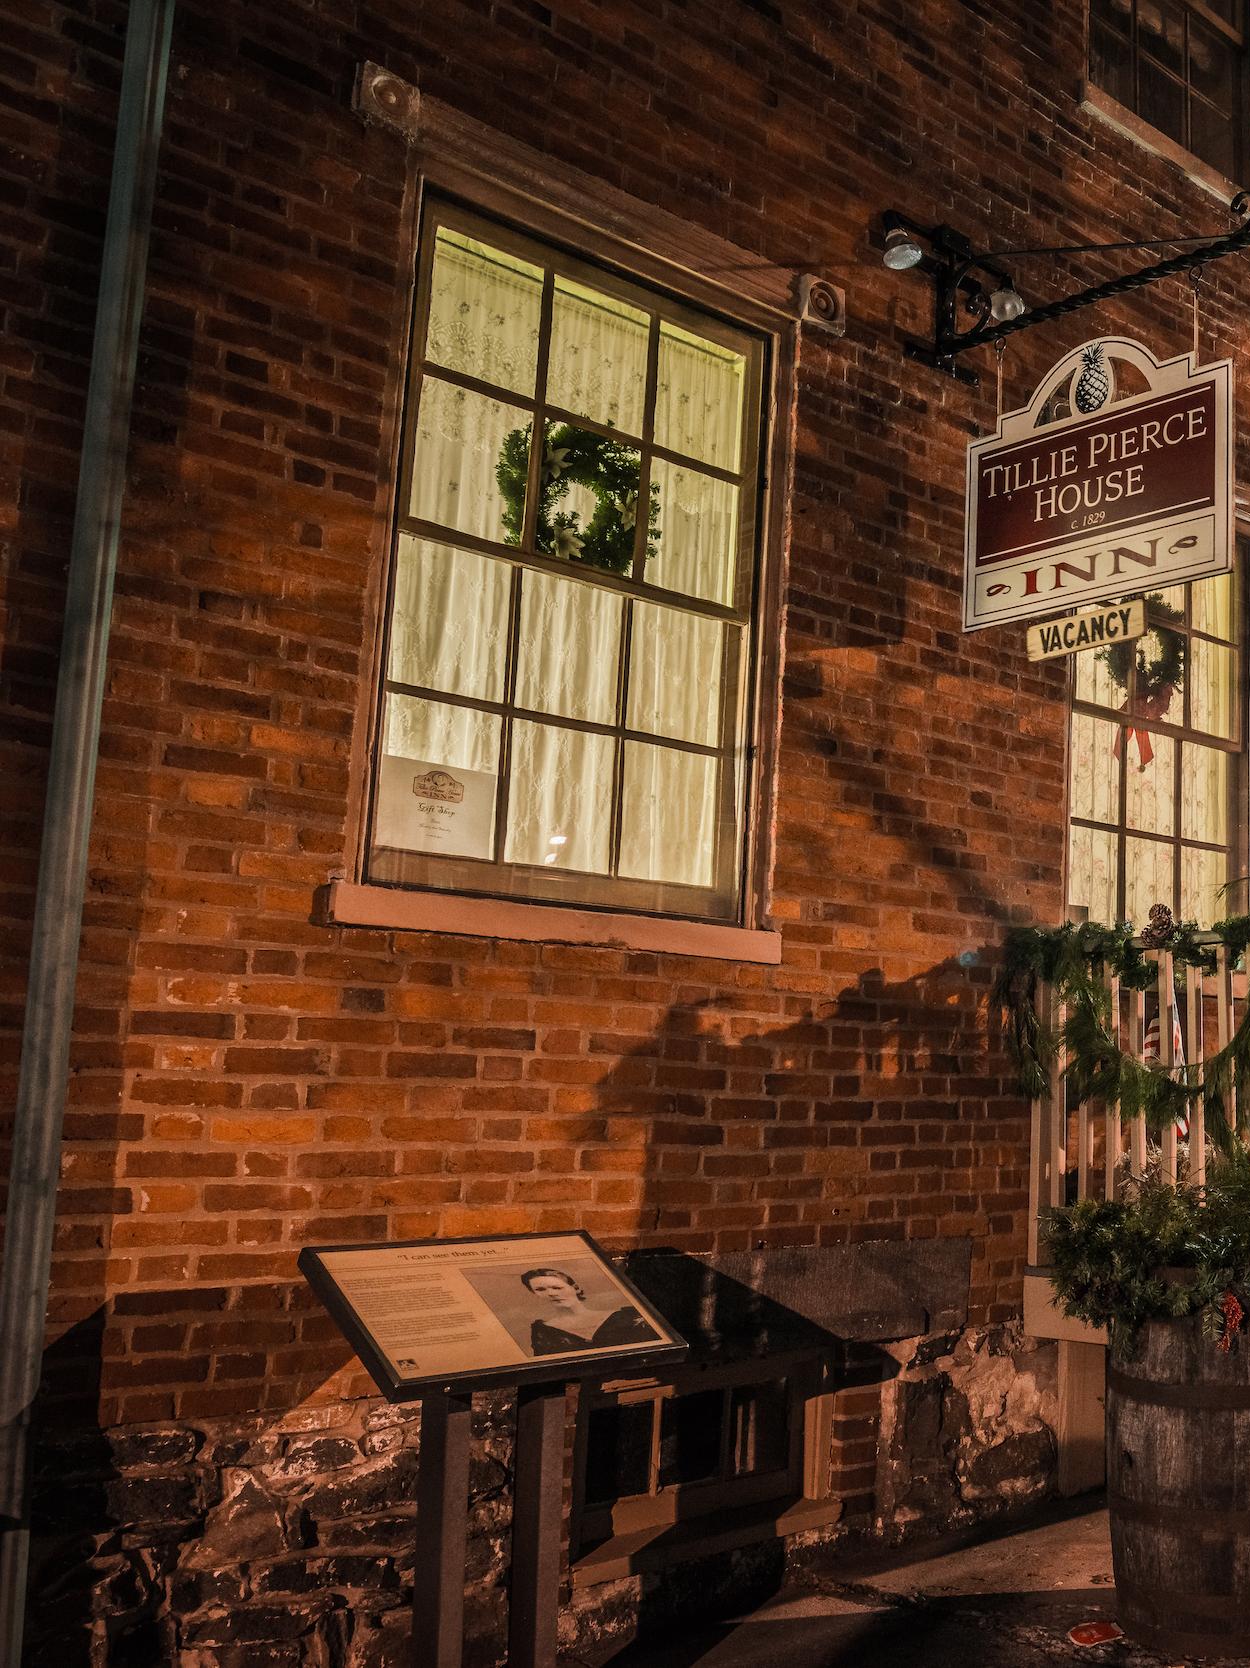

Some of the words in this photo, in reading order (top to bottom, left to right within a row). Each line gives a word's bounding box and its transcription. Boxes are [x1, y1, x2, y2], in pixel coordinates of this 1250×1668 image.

[982, 445, 1079, 499] TILLIE
[1087, 406, 1208, 470] PIERCE
[1033, 464, 1146, 523] HOUSE
[1082, 511, 1106, 528] 1829
[1019, 536, 1165, 599] INN
[1038, 606, 1133, 655] VACANCY
[451, 1250, 479, 1258] them
